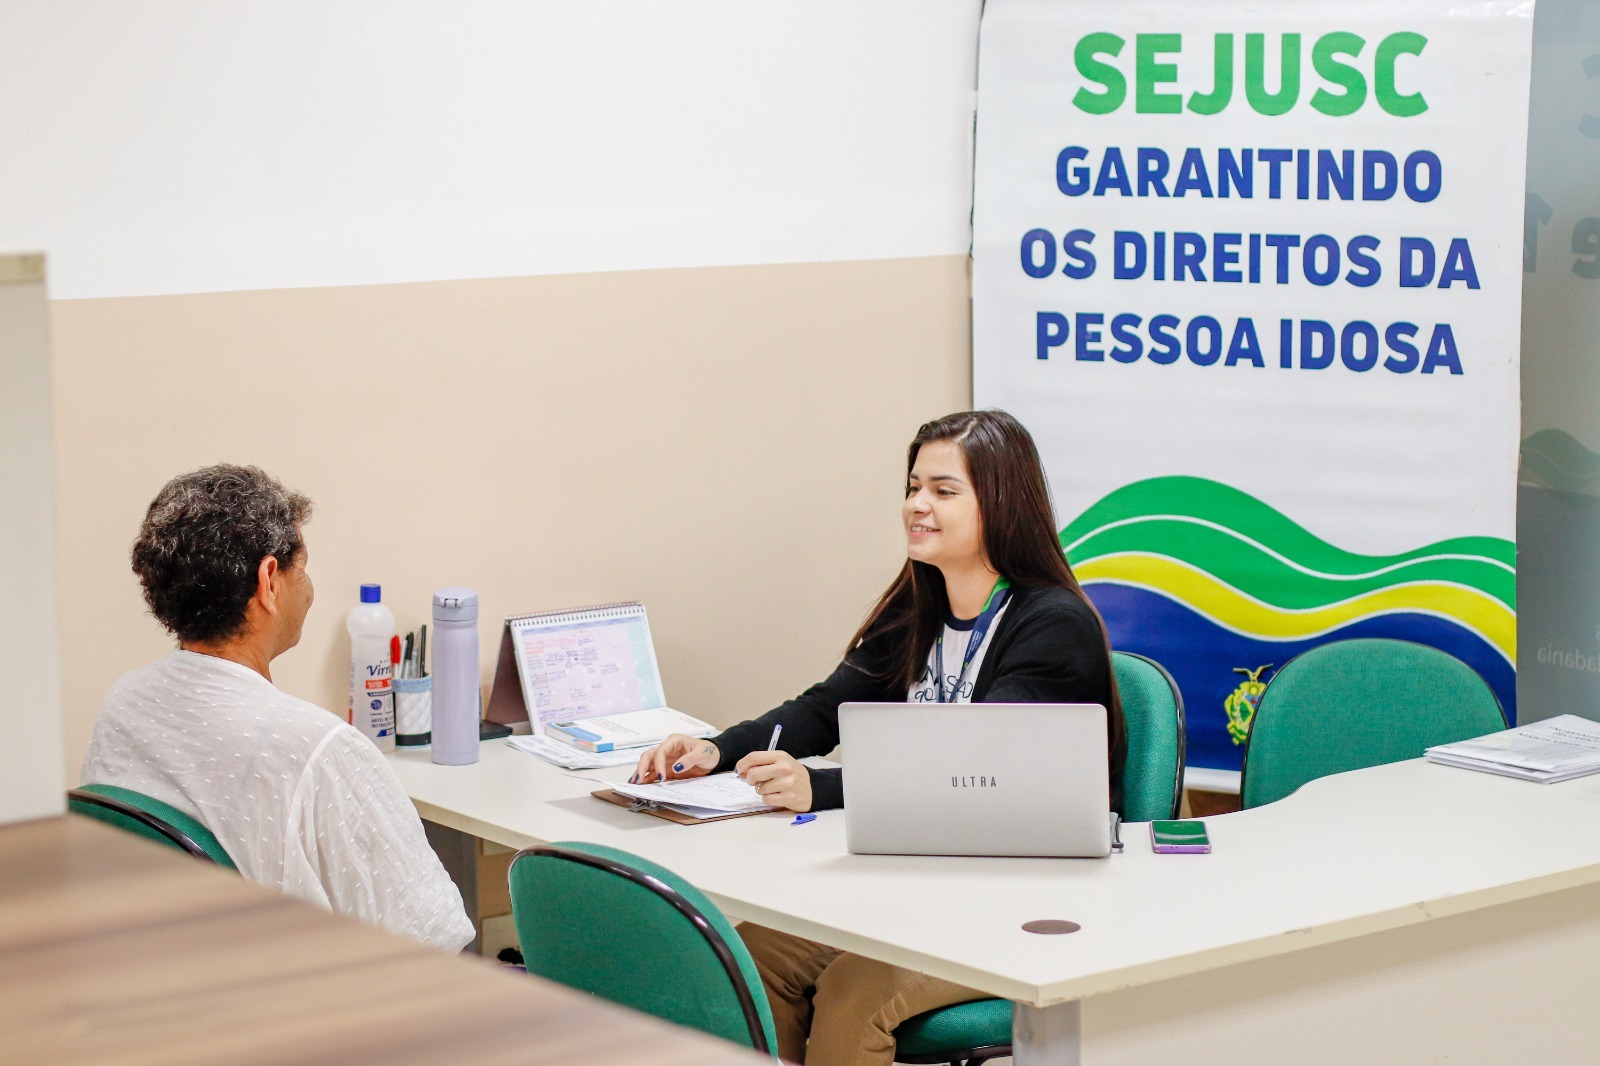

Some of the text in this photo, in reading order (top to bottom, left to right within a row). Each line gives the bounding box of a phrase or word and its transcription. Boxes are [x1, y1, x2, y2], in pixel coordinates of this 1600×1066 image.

[1072, 31, 1429, 117] SEJUSC
[1056, 146, 1442, 203] GARANTINDO
[1021, 228, 1481, 290] OS DIREITOS DA
[1036, 311, 1464, 376] PESSOA IDOSA
[951, 776, 997, 788] ULTRA
